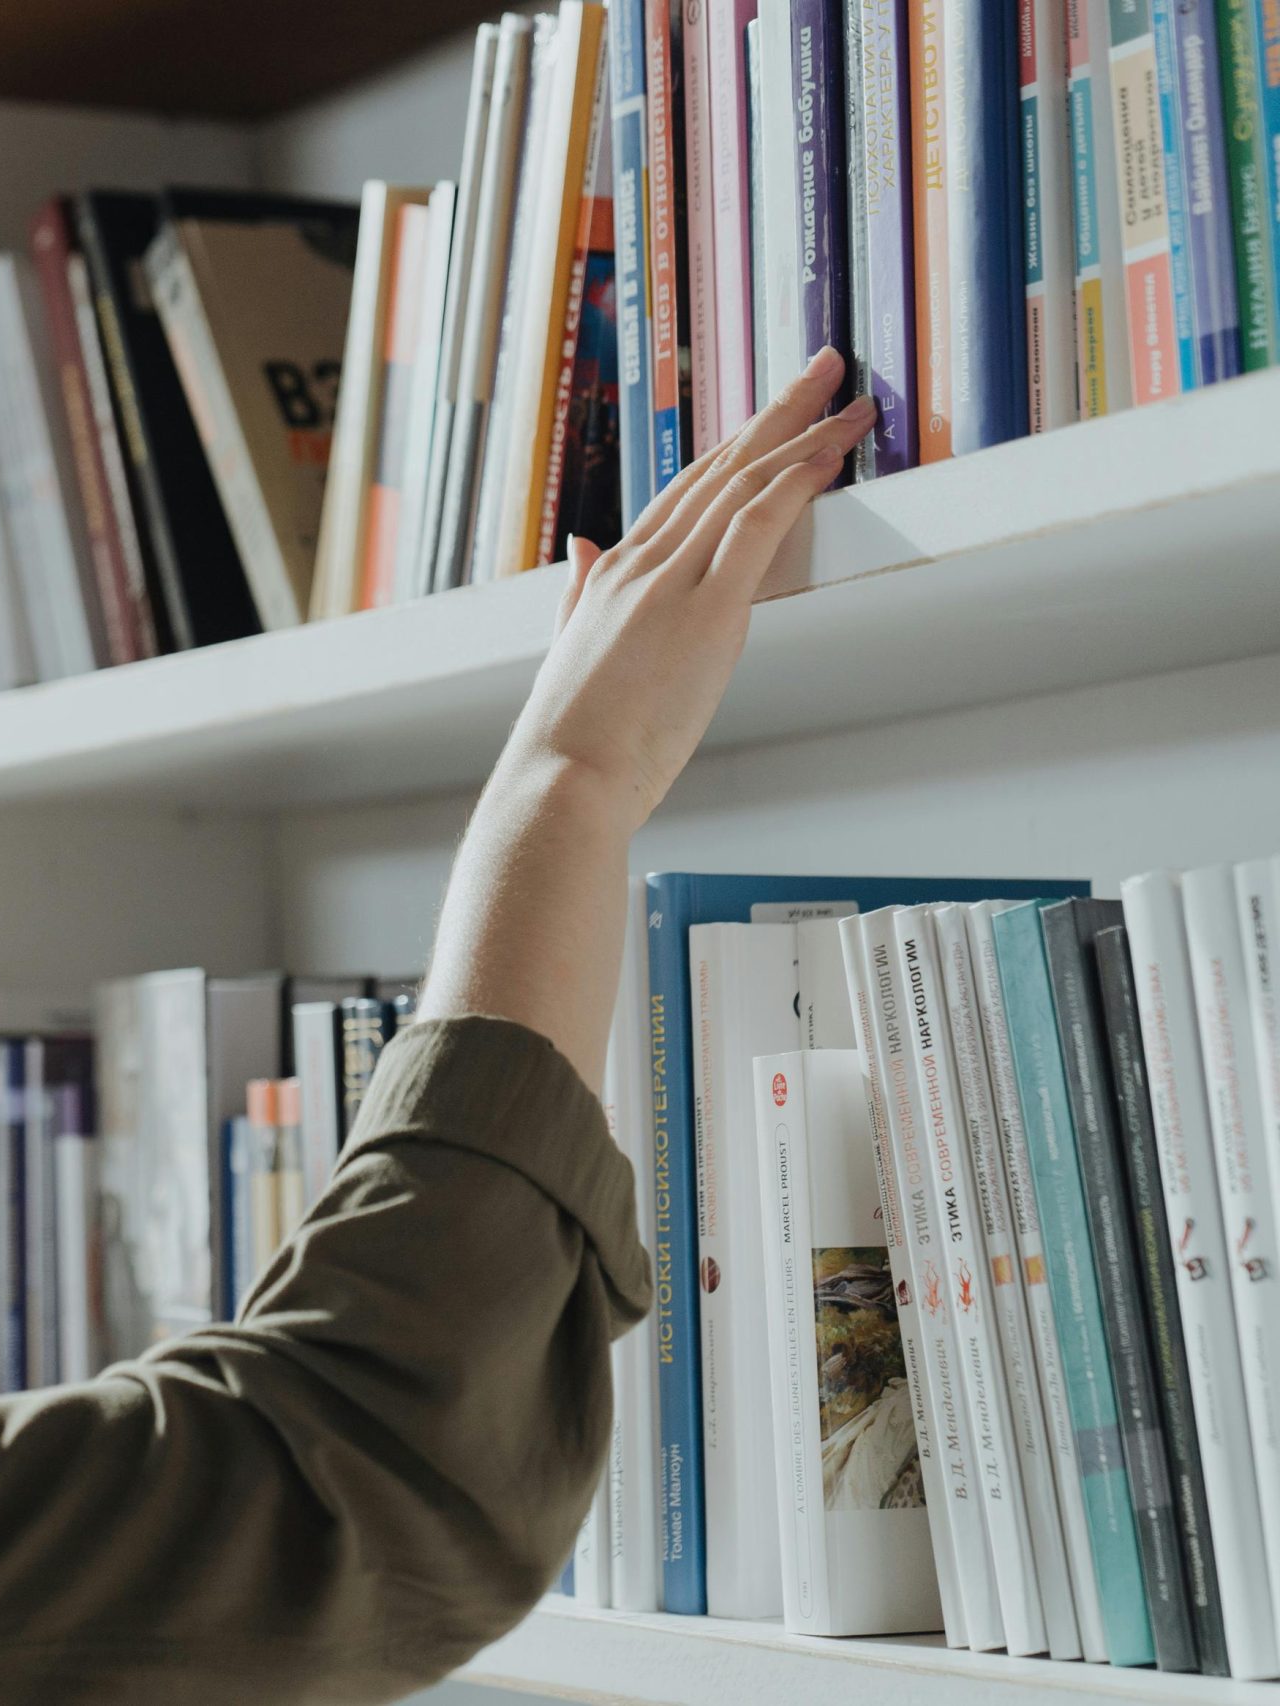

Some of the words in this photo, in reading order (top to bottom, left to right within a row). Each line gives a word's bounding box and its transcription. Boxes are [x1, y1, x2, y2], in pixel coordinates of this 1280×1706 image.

[921, 12, 937, 37] И
[797, 26, 817, 144] бабушки
[1182, 32, 1208, 131] Оклендер
[719, 92, 734, 177] просто
[863, 43, 881, 216] ПСИХОПАТИИ
[878, 47, 897, 189] ХАРАКТЕРА
[922, 44, 943, 191] ДЕТСТВО
[1025, 114, 1035, 174] школы
[1073, 92, 1086, 154] детьми
[1144, 68, 1163, 197] подростков
[692, 129, 703, 212] САМАНТА
[1119, 86, 1137, 227] Самооценка
[1134, 139, 1151, 200] детей
[1190, 134, 1214, 216] Вайолет
[618, 168, 638, 275] КРИЗИСЕ
[799, 151, 817, 284] Рождение
[1026, 177, 1036, 208] без
[1078, 175, 1092, 256] Общение
[654, 251, 671, 271] в
[1028, 211, 1038, 269] Жизнь
[564, 260, 586, 332] СЕБЕ
[621, 279, 638, 301] В
[654, 279, 672, 362] Гнев
[696, 301, 707, 327] НА
[927, 272, 944, 369] Эриксон
[562, 339, 576, 360] В
[622, 304, 640, 385] СЕМЬЯ
[881, 313, 896, 380] Личко
[697, 378, 709, 432] КОГДА
[882, 389, 896, 411] Е.
[882, 418, 896, 440] А.
[929, 375, 945, 433] Эрик
[698, 960, 712, 1016] ТРАВМЫ
[872, 943, 904, 1055] НАРКОЛОГИИ
[903, 938, 933, 1050] НАРКОЛОГИИ
[952, 941, 972, 1009] КАСТАНЕДЫ
[983, 938, 1002, 1008] КАСТАНЕДЫ
[857, 991, 874, 1053] ПСИХИАТРИИ
[963, 1010, 982, 1064] КАРЛОСА
[994, 1010, 1012, 1064] КАРЛОСА
[1147, 962, 1172, 1062] БЕЗУМСТВАХ
[1210, 956, 1236, 1060] БЕЗУМСТВАХ
[699, 1019, 714, 1122] ПСИХОТЕРАПИИ
[868, 1062, 888, 1130] ДИАГНОСТИКИ
[971, 1066, 989, 1112] ЗНАНИЯ
[1003, 1066, 1021, 1111] ЗНАНИЯ
[650, 994, 671, 1233] ПСИХОТЕРАПИИ
[695, 1096, 706, 1169] ПРОШЛОГО
[704, 1125, 714, 1140] по
[888, 1058, 923, 1185] СОВРЕМЕННОЙ
[922, 1053, 954, 1183] СОВРЕМЕННОЙ
[979, 1114, 993, 1145] ПУТИ
[1011, 1114, 1024, 1145] ПУТИ
[1162, 1066, 1187, 1171] АКТУАЛЬНЫХ
[1225, 1065, 1250, 1170] АКТУАЛЬНЫХ
[704, 1142, 718, 1238] РУКОВОДСТВО
[778, 1140, 791, 1189] PROUST
[878, 1131, 904, 1249] ФЕНОМЕНОЛОГИЧЕСКОЙ
[779, 1193, 792, 1244] MARCEL
[910, 1189, 932, 1247] ЭТИКА
[943, 1186, 964, 1243] ЭТИКА
[976, 1171, 996, 1236] ПЕРЕСЕКАЯ
[1009, 1170, 1028, 1235] ПЕРЕСЕКАЯ
[656, 1239, 676, 1365] ИСТОКИ
[783, 1256, 796, 1304] FLEURS
[786, 1307, 797, 1324] EN
[787, 1327, 798, 1368] FILLES
[789, 1370, 801, 1417] JEUNES
[905, 1337, 926, 1423] Менделевич
[933, 1338, 961, 1453] Менделевич
[966, 1336, 995, 1453] Менделевич
[790, 1420, 802, 1446] DES
[919, 1425, 930, 1442] Д.
[921, 1445, 933, 1459] В.
[668, 1443, 684, 1508] Малоун
[792, 1449, 804, 1502] L'OMBRE
[952, 1458, 967, 1479] Д.
[955, 1482, 969, 1501] В.
[985, 1458, 999, 1479] Д.
[988, 1482, 1002, 1501] В.
[669, 1510, 683, 1563] Томас
